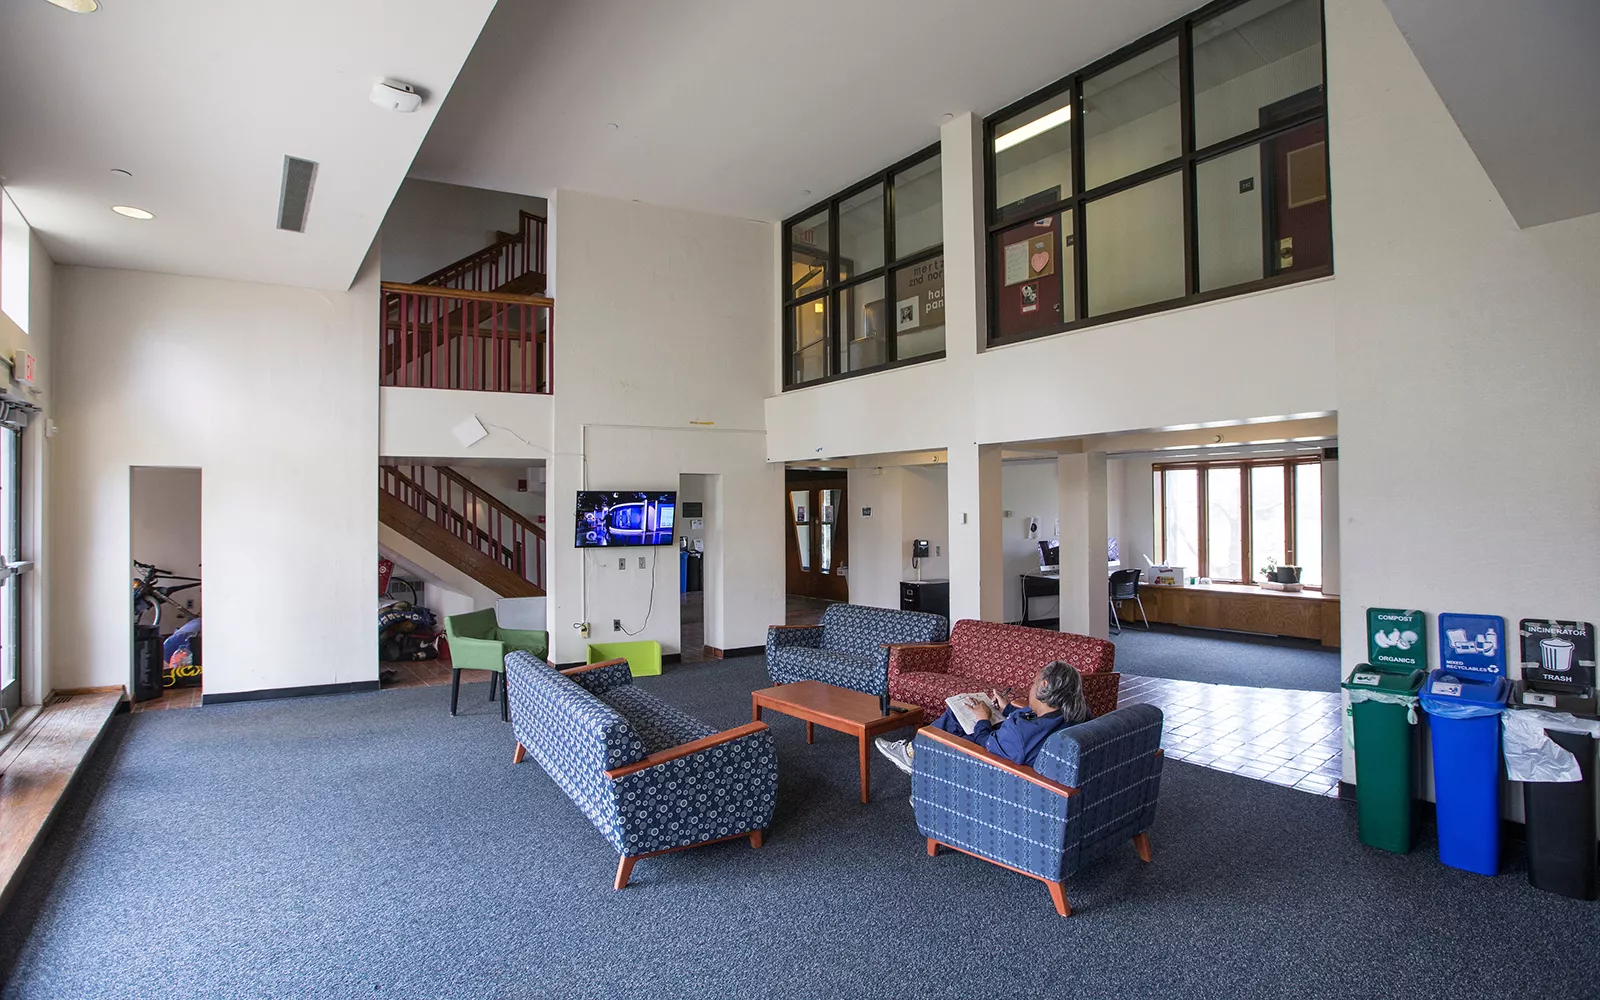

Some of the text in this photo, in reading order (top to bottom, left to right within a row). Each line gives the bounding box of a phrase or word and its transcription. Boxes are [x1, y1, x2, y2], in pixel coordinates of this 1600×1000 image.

[914, 260, 944, 276] mertz
[928, 287, 944, 300] hal
[925, 299, 944, 314] pan
[1378, 614, 1413, 622] COMPOST
[1528, 626, 1586, 637] INCINERATOR
[1378, 655, 1416, 664] ORGANICS
[1446, 664, 1488, 673] RECYCLABLES
[1542, 673, 1573, 683] TRASH
